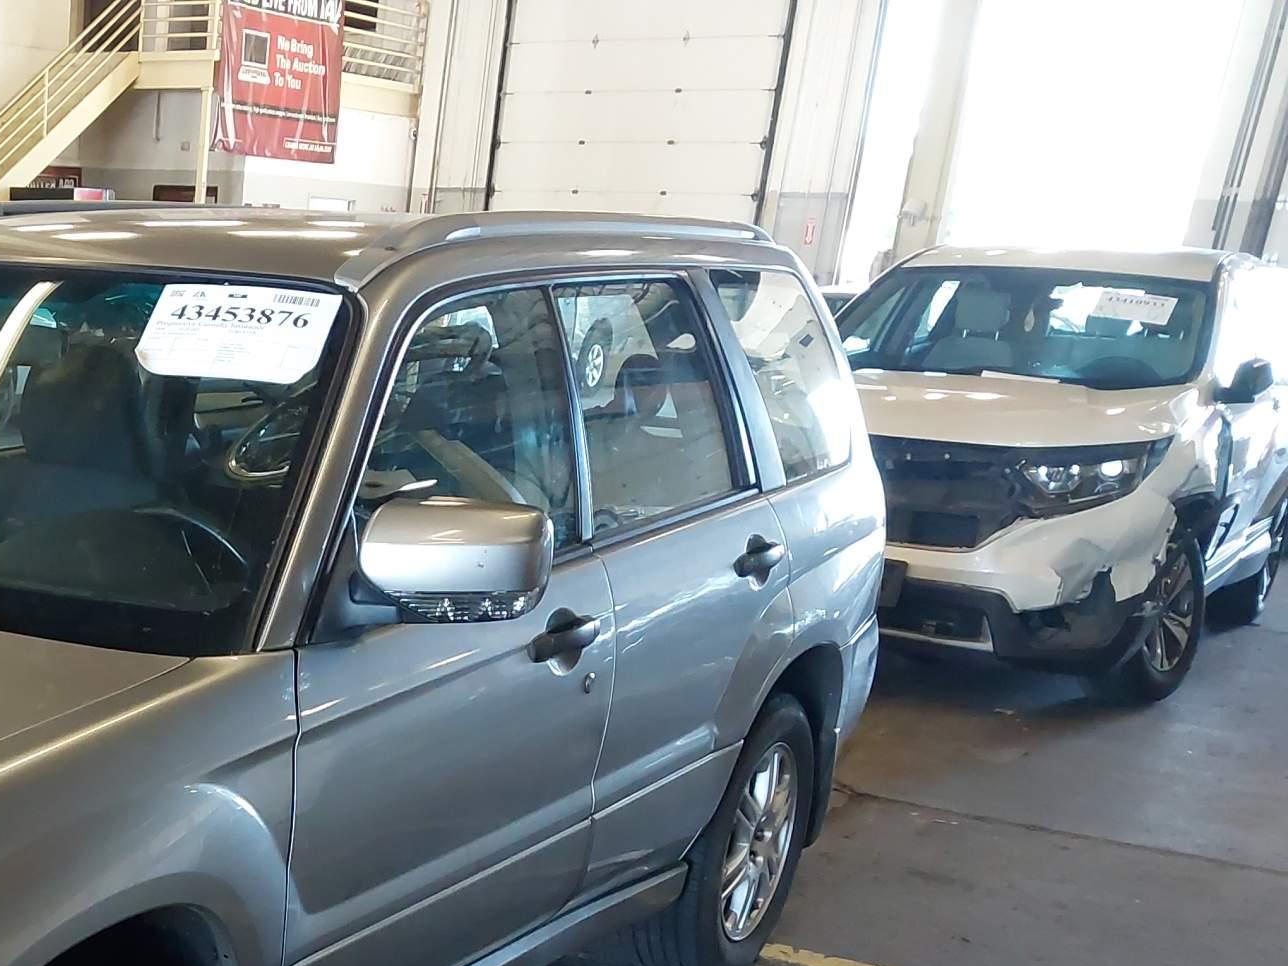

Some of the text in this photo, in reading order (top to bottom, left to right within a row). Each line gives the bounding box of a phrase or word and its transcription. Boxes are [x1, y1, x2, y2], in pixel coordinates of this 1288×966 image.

[290, 38, 313, 58] Bring
[276, 54, 325, 75] The Auction
[274, 71, 301, 89] To You
[170, 304, 311, 329] 43453876
